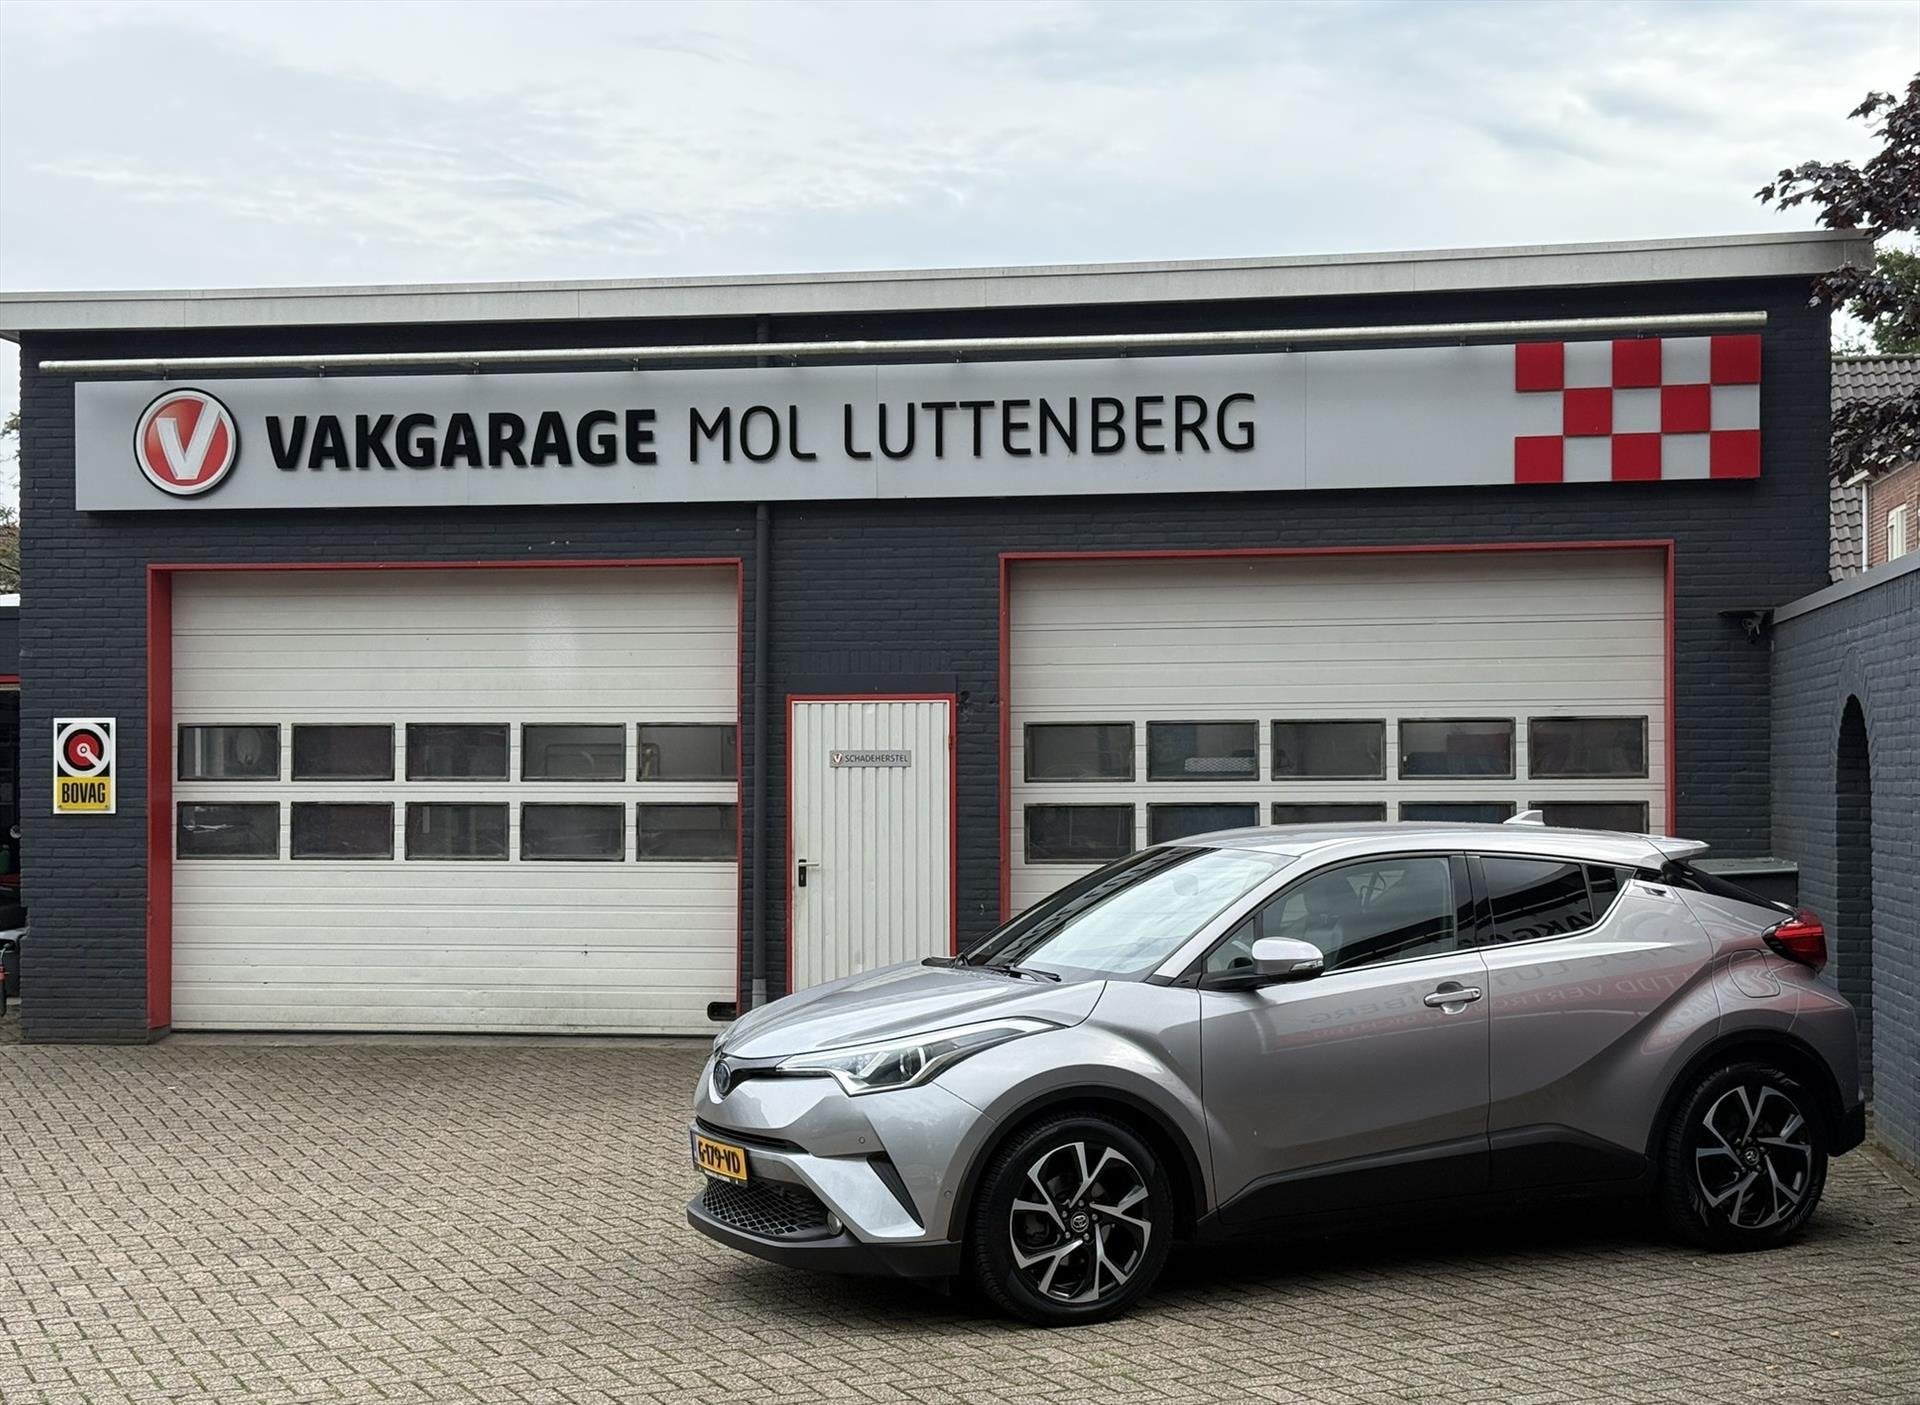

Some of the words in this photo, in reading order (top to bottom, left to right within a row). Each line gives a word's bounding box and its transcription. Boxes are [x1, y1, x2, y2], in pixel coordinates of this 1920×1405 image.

[266, 409, 657, 469] VAKGARAGE
[689, 404, 817, 462] MOL
[843, 393, 1255, 459] LUTTENBERG
[845, 754, 908, 763] SCHADEHERSTEL
[61, 782, 106, 803] BOVAG
